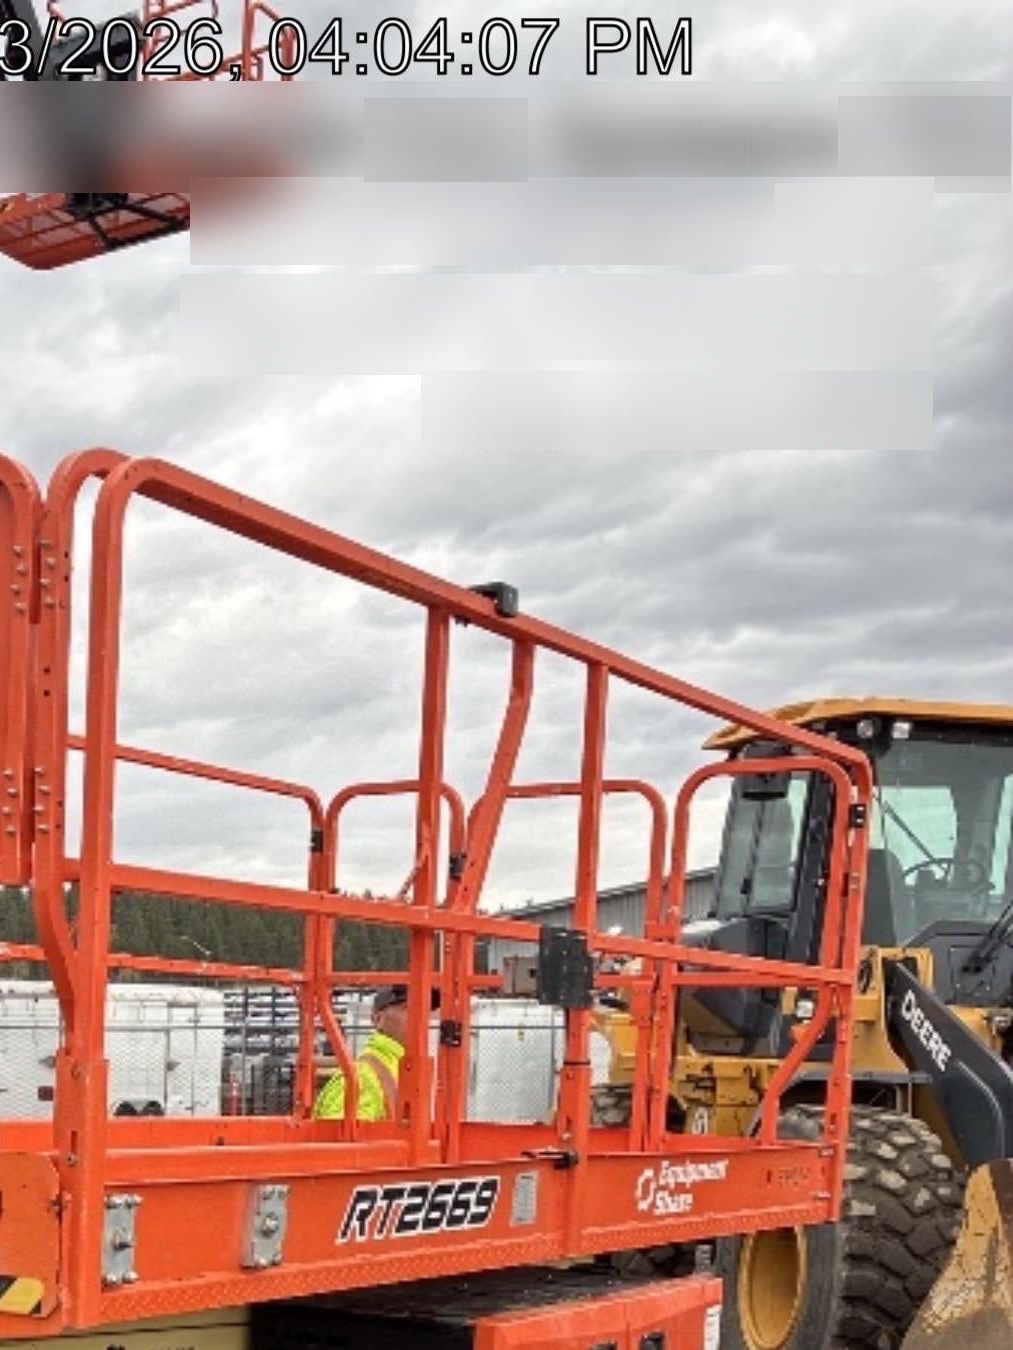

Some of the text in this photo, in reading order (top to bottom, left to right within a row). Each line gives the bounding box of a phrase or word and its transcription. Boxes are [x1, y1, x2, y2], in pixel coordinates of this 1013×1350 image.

[901, 989, 952, 1073] DEERE
[334, 1175, 501, 1246] RT2669
[652, 1190, 694, 1216] Share
